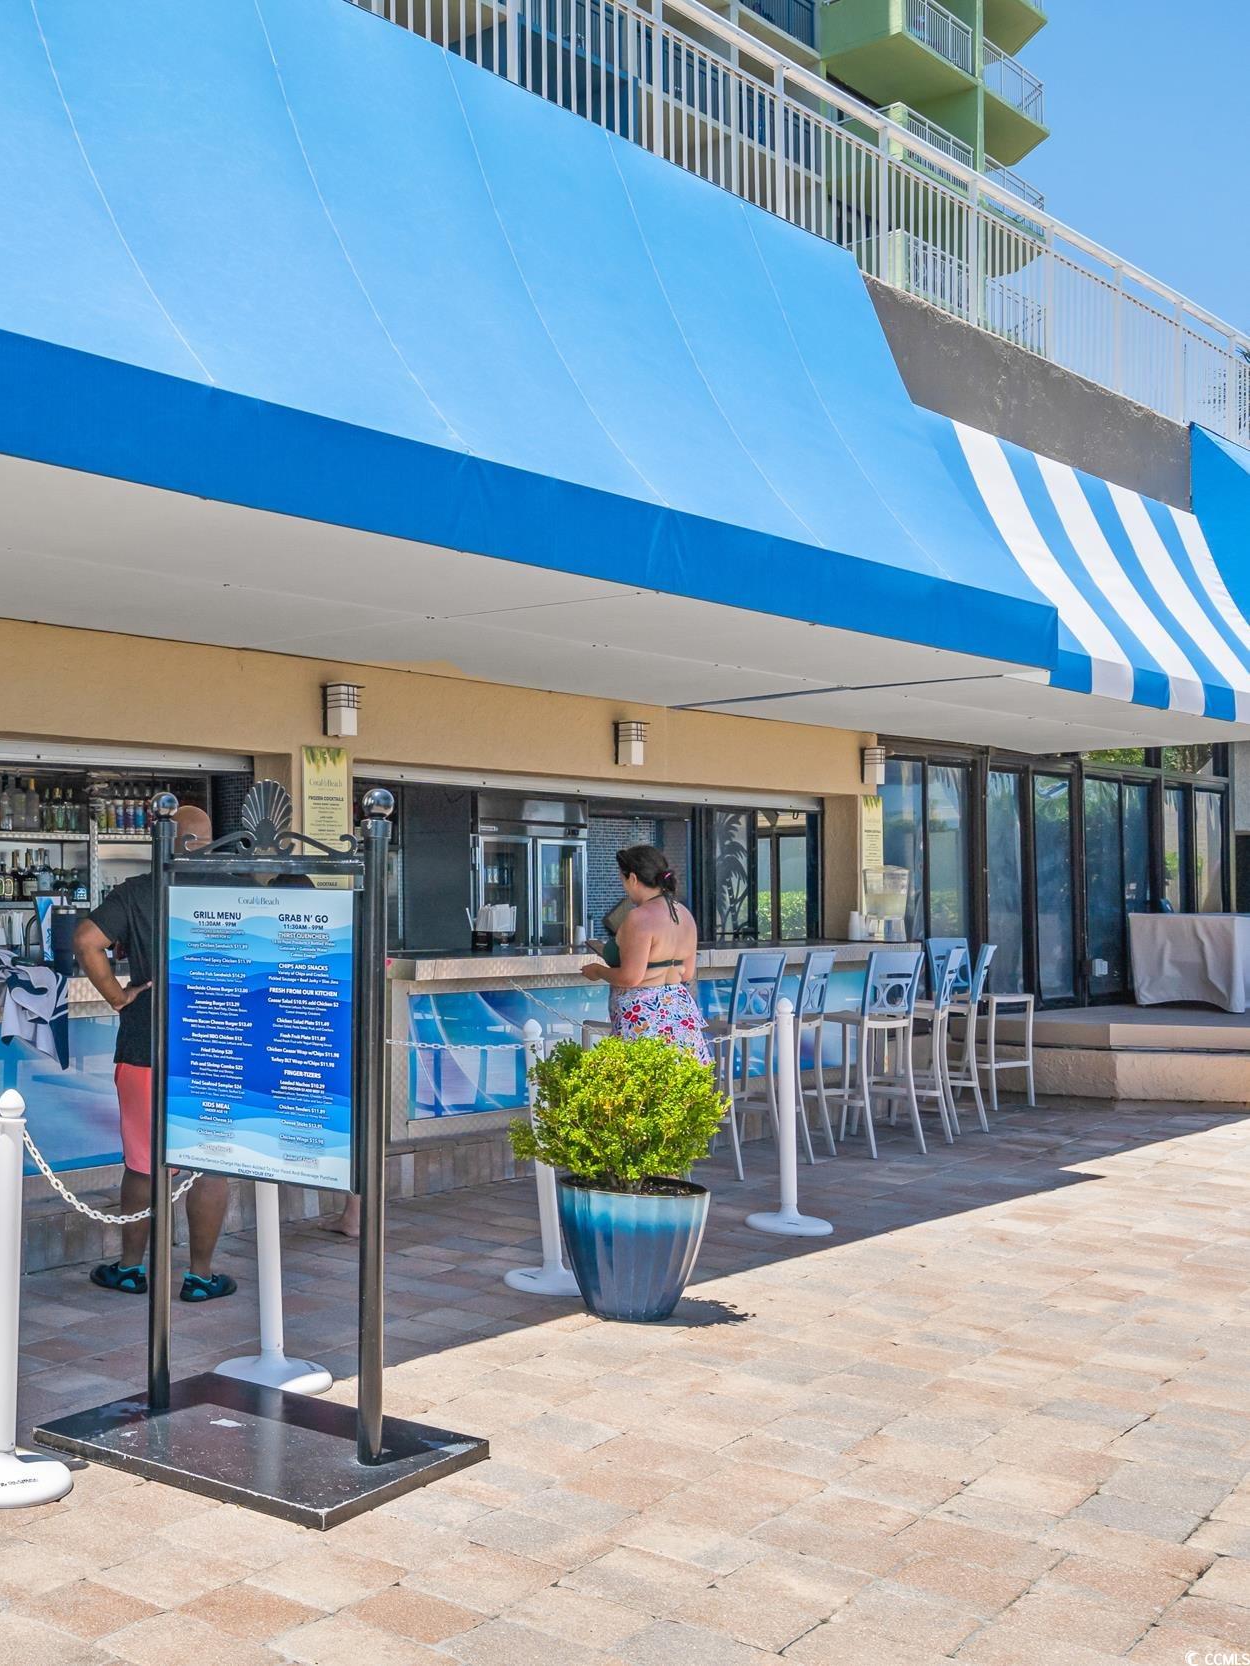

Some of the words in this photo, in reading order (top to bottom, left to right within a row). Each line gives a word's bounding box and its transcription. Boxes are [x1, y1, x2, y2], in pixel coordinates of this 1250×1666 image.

[238, 897, 255, 905] Coral
[194, 911, 215, 919] GRILL
[217, 912, 241, 920] MENU
[279, 914, 301, 922] GRAB
[315, 915, 328, 923] GO
